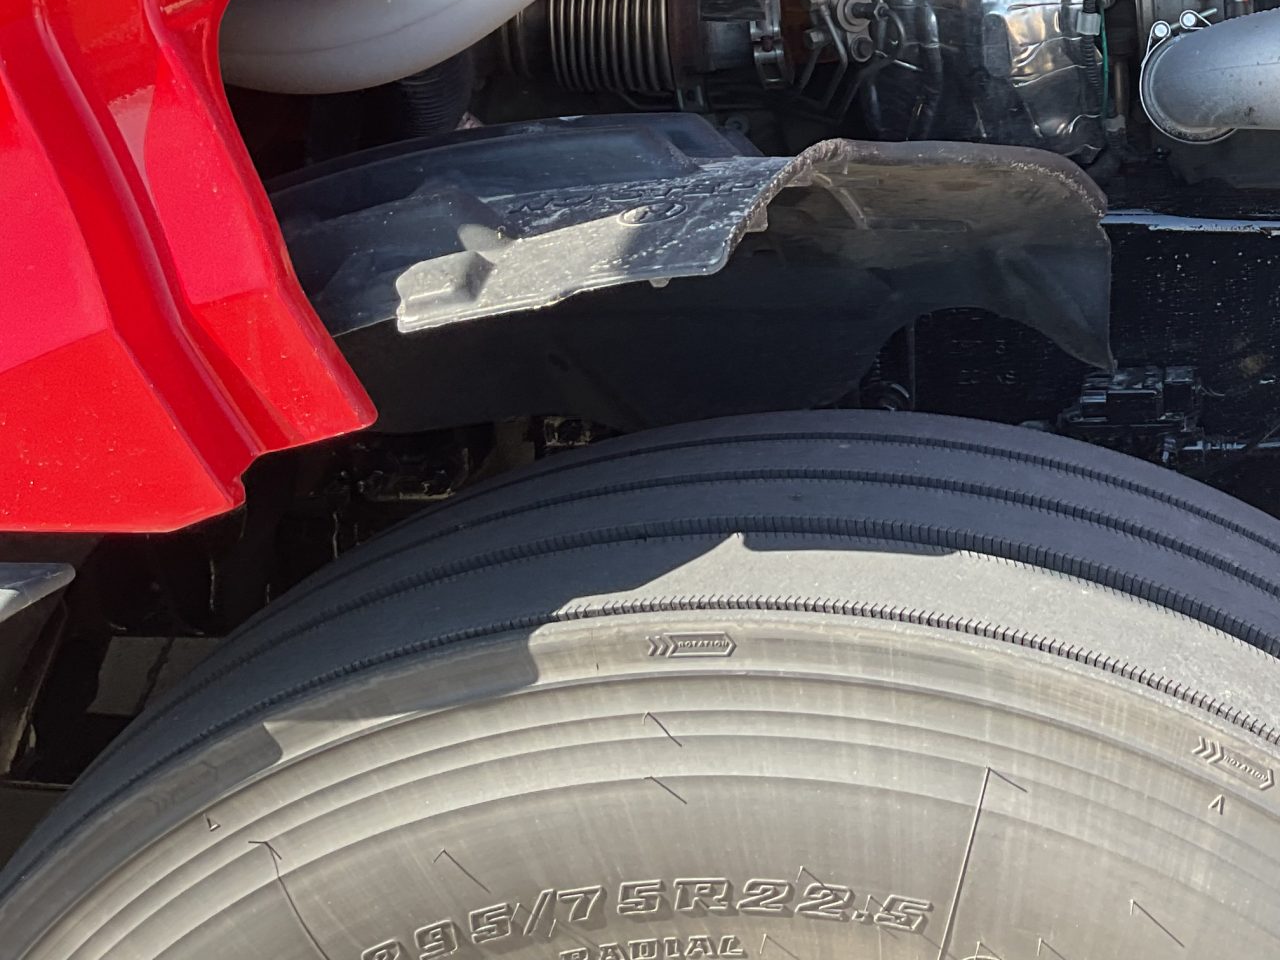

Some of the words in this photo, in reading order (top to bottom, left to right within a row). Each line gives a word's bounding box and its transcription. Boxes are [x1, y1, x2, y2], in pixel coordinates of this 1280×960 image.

[677, 639, 728, 649] ROTATION
[1222, 754, 1269, 783] ROTATION
[559, 935, 746, 960] RADIAL
